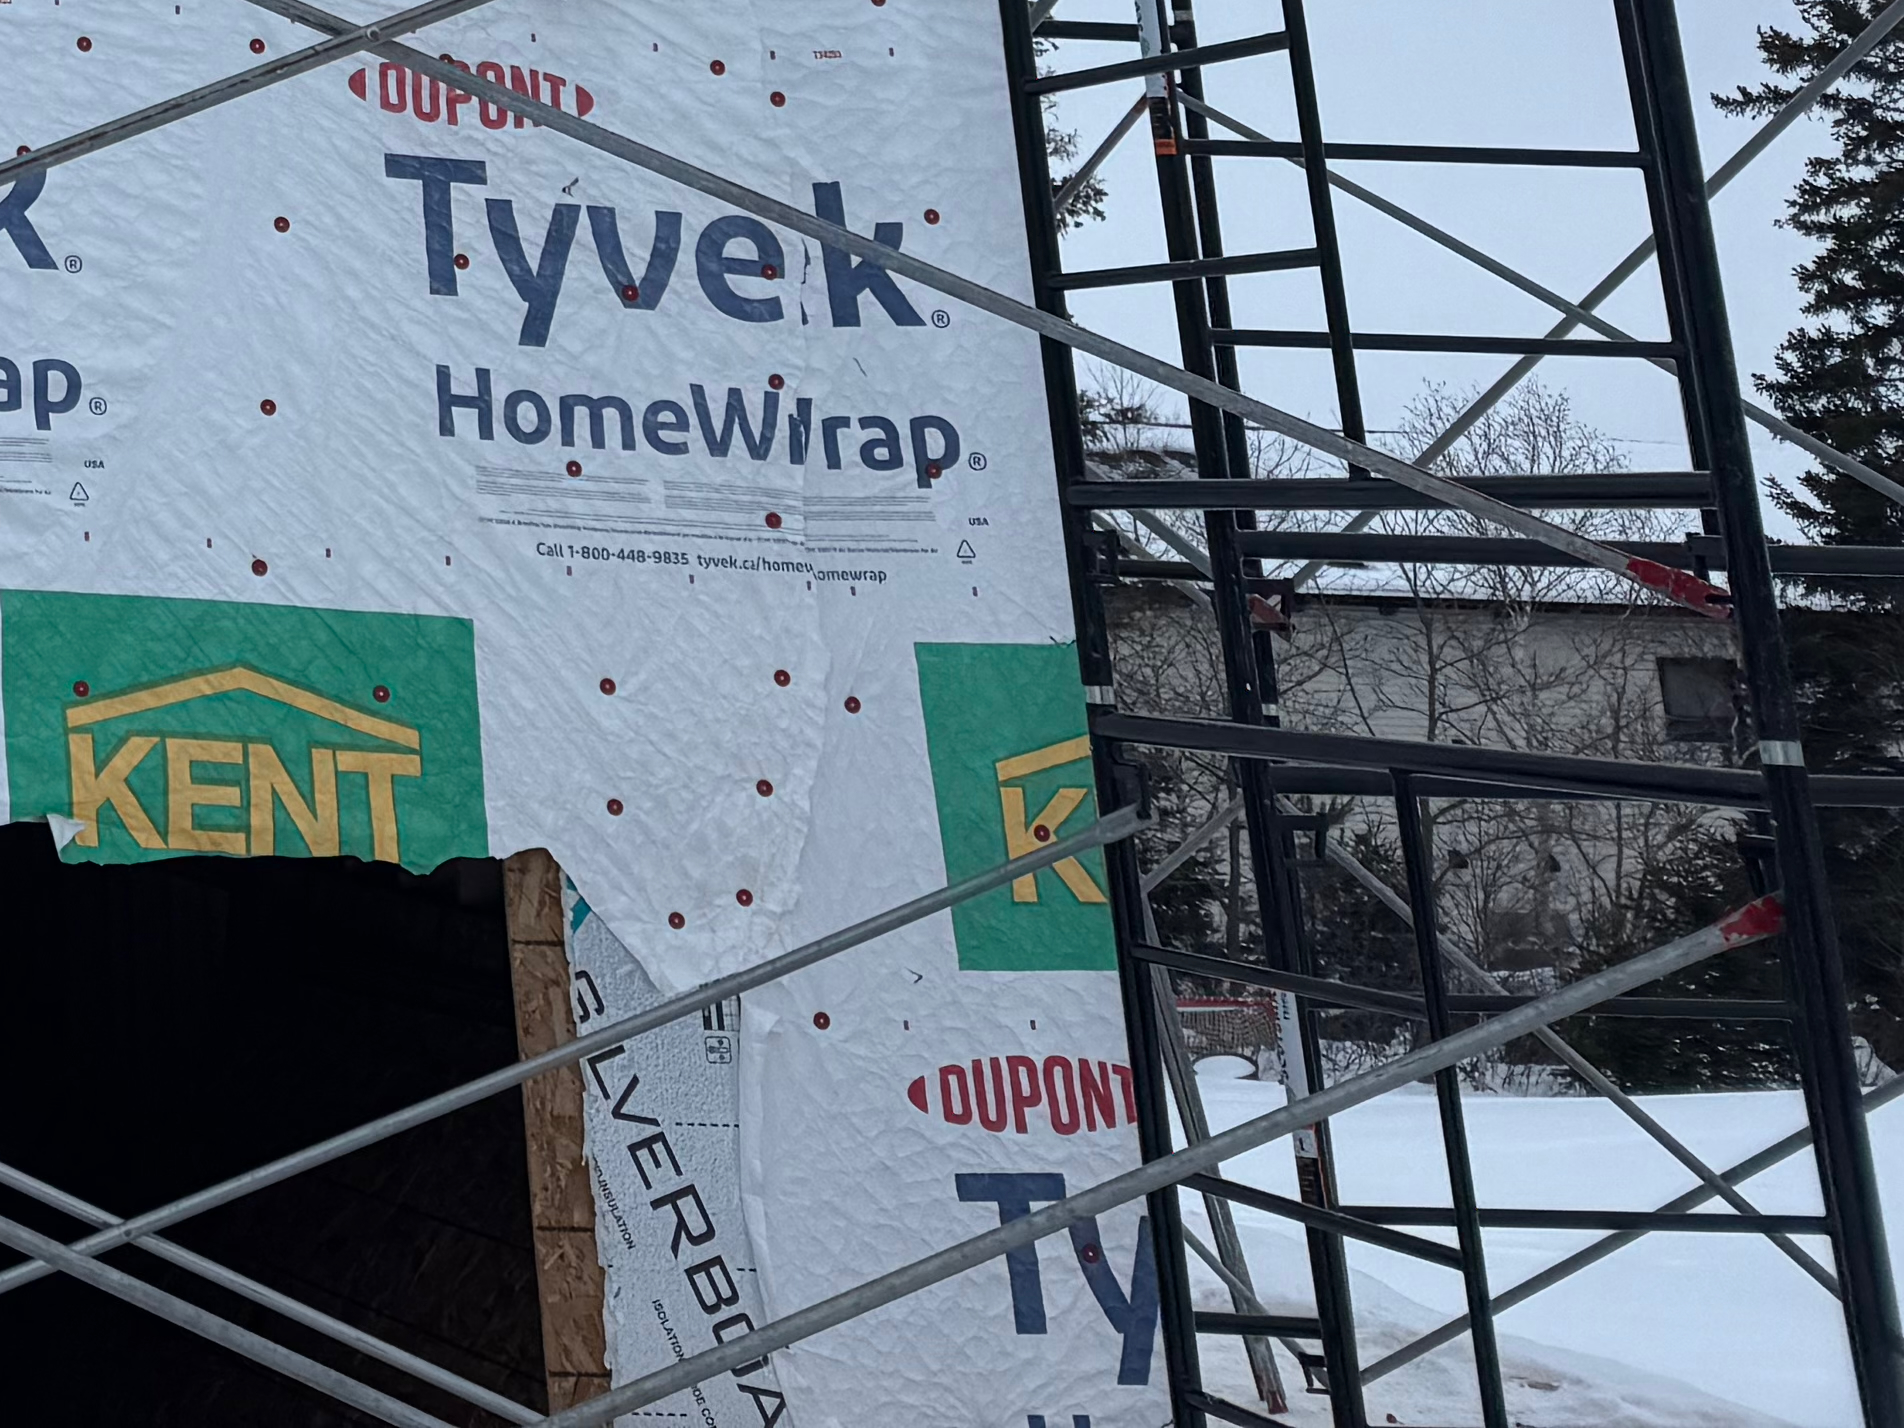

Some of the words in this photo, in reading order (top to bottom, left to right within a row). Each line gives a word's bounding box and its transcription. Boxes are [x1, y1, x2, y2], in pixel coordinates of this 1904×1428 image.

[535, 542, 564, 561] Call
[567, 544, 691, 568] 1-800-448-9835
[67, 732, 422, 865] KENT
